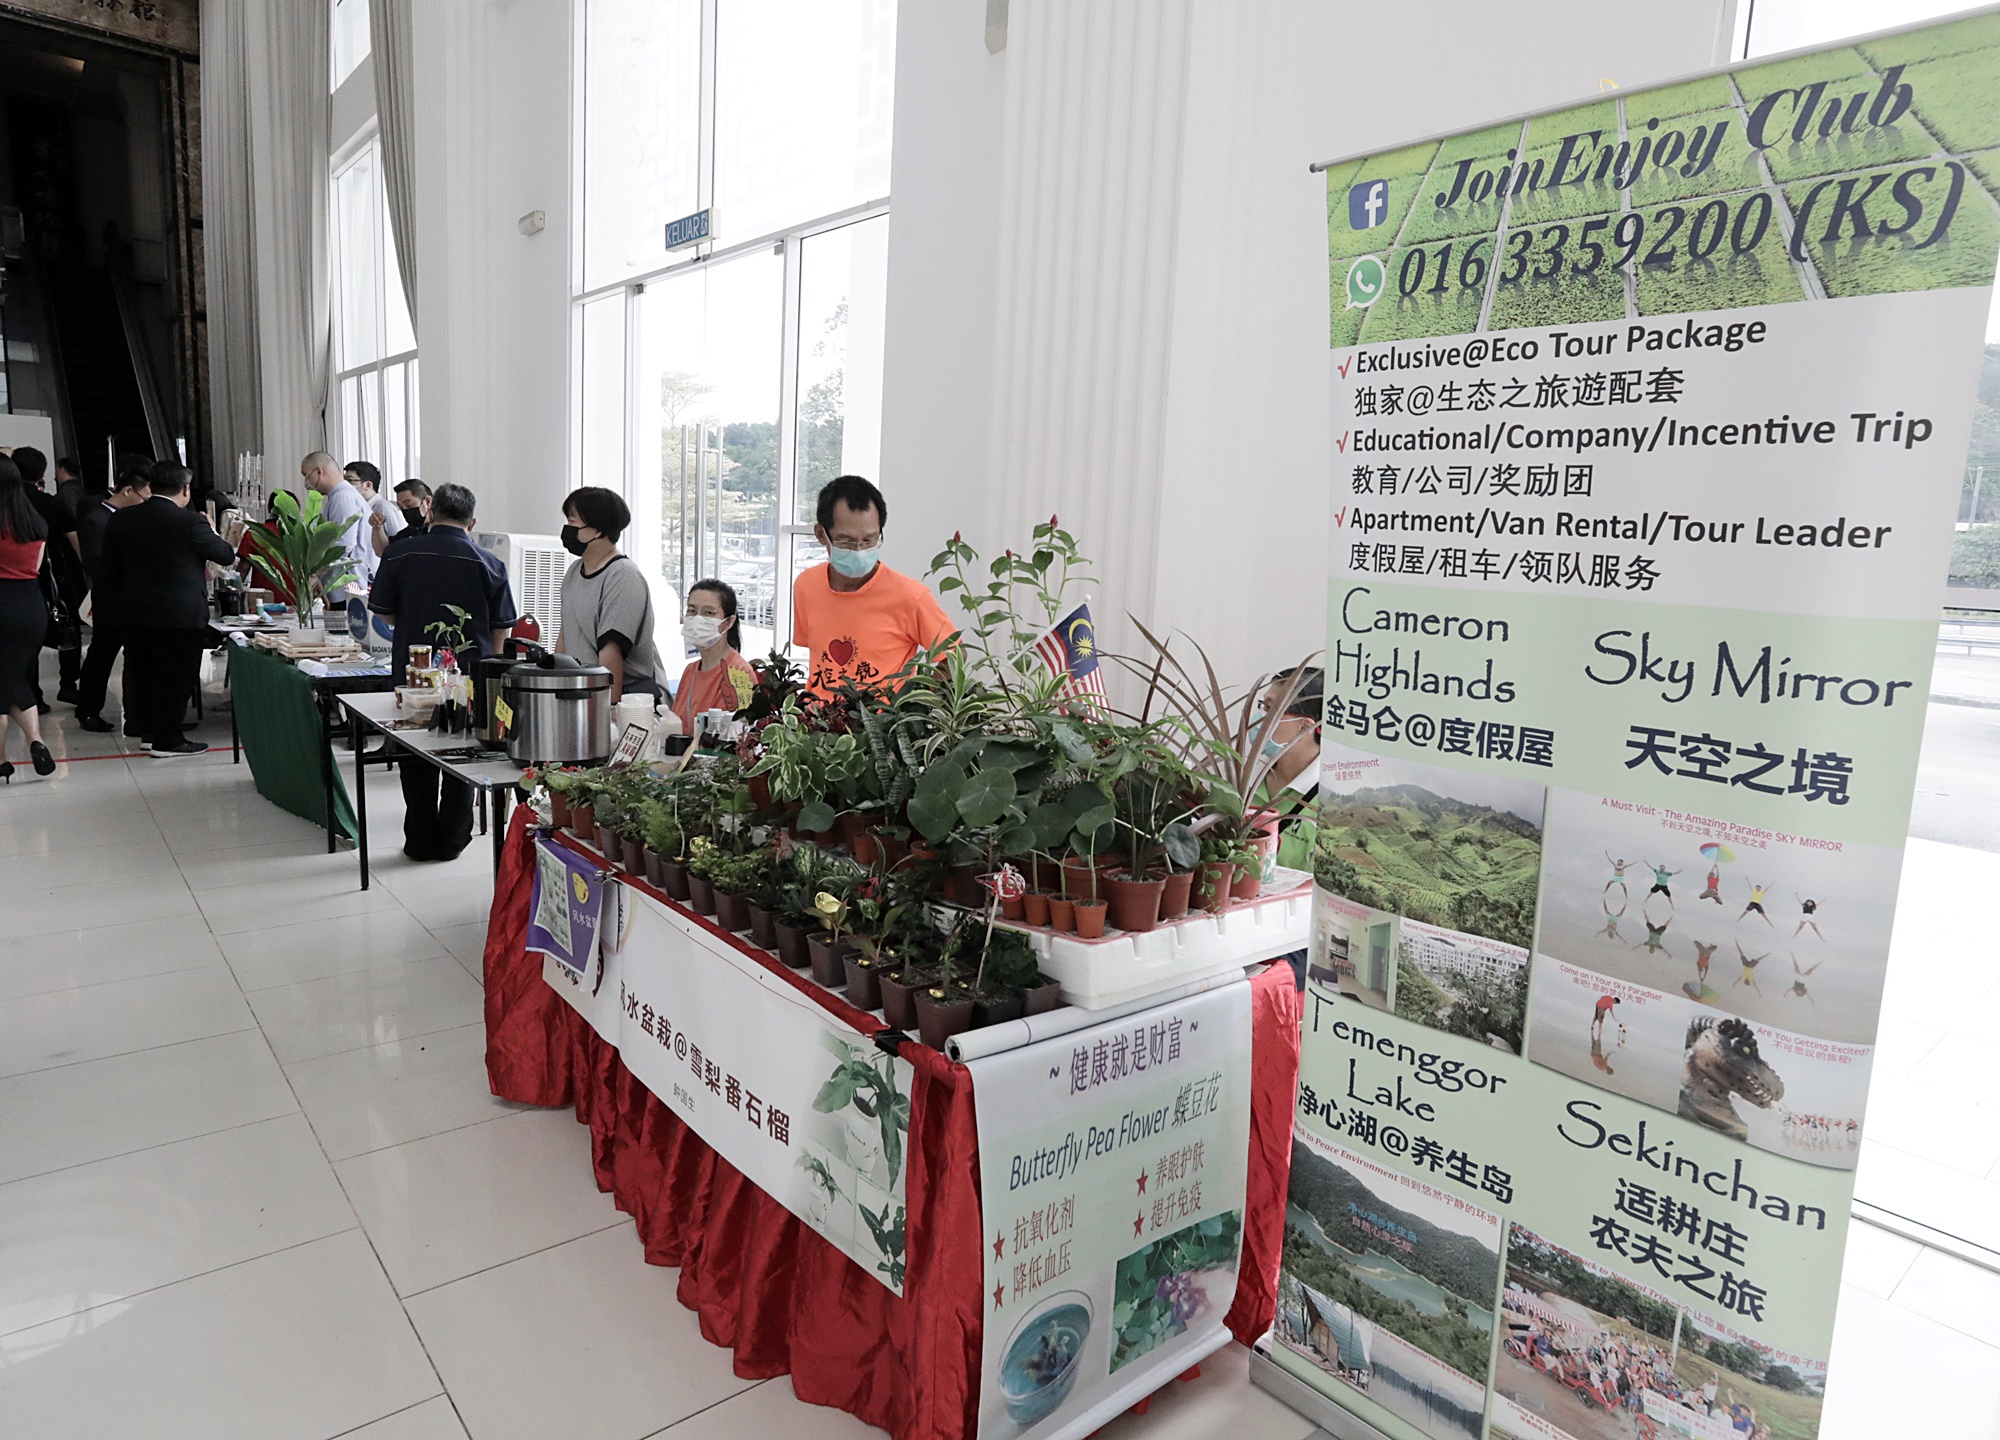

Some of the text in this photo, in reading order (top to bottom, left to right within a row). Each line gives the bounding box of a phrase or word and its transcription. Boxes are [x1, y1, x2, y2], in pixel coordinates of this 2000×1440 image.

[1434, 64, 1914, 209] JoinEnjoy Club
[666, 216, 700, 247] KELUAR
[1398, 161, 1966, 297] 016 3359200 (KS)
[1356, 319, 1767, 373] Exclusive@Eco Tour Package
[1354, 366, 1686, 417] 独家@生态之旅遊配套
[1353, 410, 1933, 455] Educational/Company/Incentive Trip
[1351, 463, 1594, 498] 教育/公司/奖励团
[1350, 507, 1892, 549] Apartment/Van Rental/Tour Leader
[1348, 541, 1661, 591] 度假屋/租车/领队服务
[1342, 586, 1509, 642] Cameron
[372, 645, 387, 654] BADAN
[1335, 639, 1516, 704] Highlands
[1584, 630, 1913, 708] Sky Mirror
[1325, 694, 1555, 768] 金马仑@度假屋
[1337, 758, 1380, 771] Environment
[1624, 724, 1854, 806] 天空之境
[1601, 797, 1609, 807] A
[1610, 799, 1633, 812] Must
[1635, 803, 1656, 816] Visit
[1664, 809, 1683, 821] The
[1685, 813, 1728, 831] Amazing
[1729, 822, 1773, 840] Paradise
[1775, 832, 1797, 845] SKY
[1799, 836, 1843, 852] MIRROR
[1560, 964, 1579, 976] Come
[1580, 971, 1590, 979] on
[1595, 976, 1612, 986] Your
[1613, 981, 1626, 991] Sky
[1628, 985, 1662, 1001] Paradise!
[1069, 1016, 1183, 1096] 健康就是财富
[1308, 988, 1507, 1093] Temenggor
[1757, 1027, 1870, 1056] Are You Getting Excited?
[1347, 1058, 1435, 1122] Lake
[1009, 1132, 1083, 1191] Butterfly
[1085, 1126, 1116, 1160] Pea
[1119, 1106, 1169, 1145] Flower
[1155, 1139, 1205, 1191] 养眼护肤
[1306, 1131, 1314, 1142] to
[1315, 1137, 1339, 1155] Peace
[1340, 1150, 1398, 1182] Environment
[1557, 1100, 1826, 1230] Sekinchan
[1013, 1194, 1076, 1255] 抗氧化剂
[1150, 1180, 1202, 1231] 提升免疫
[1614, 1177, 1749, 1267] 适耕庄
[1013, 1239, 1072, 1302] 降低血压
[1576, 1256, 1598, 1271] Back
[1599, 1267, 1609, 1275] to
[1610, 1271, 1647, 1293] Natural
[1648, 1284, 1669, 1303] Trip
[1589, 1214, 1767, 1323] 农夫之旅
[1507, 1401, 1529, 1417] Cycling
